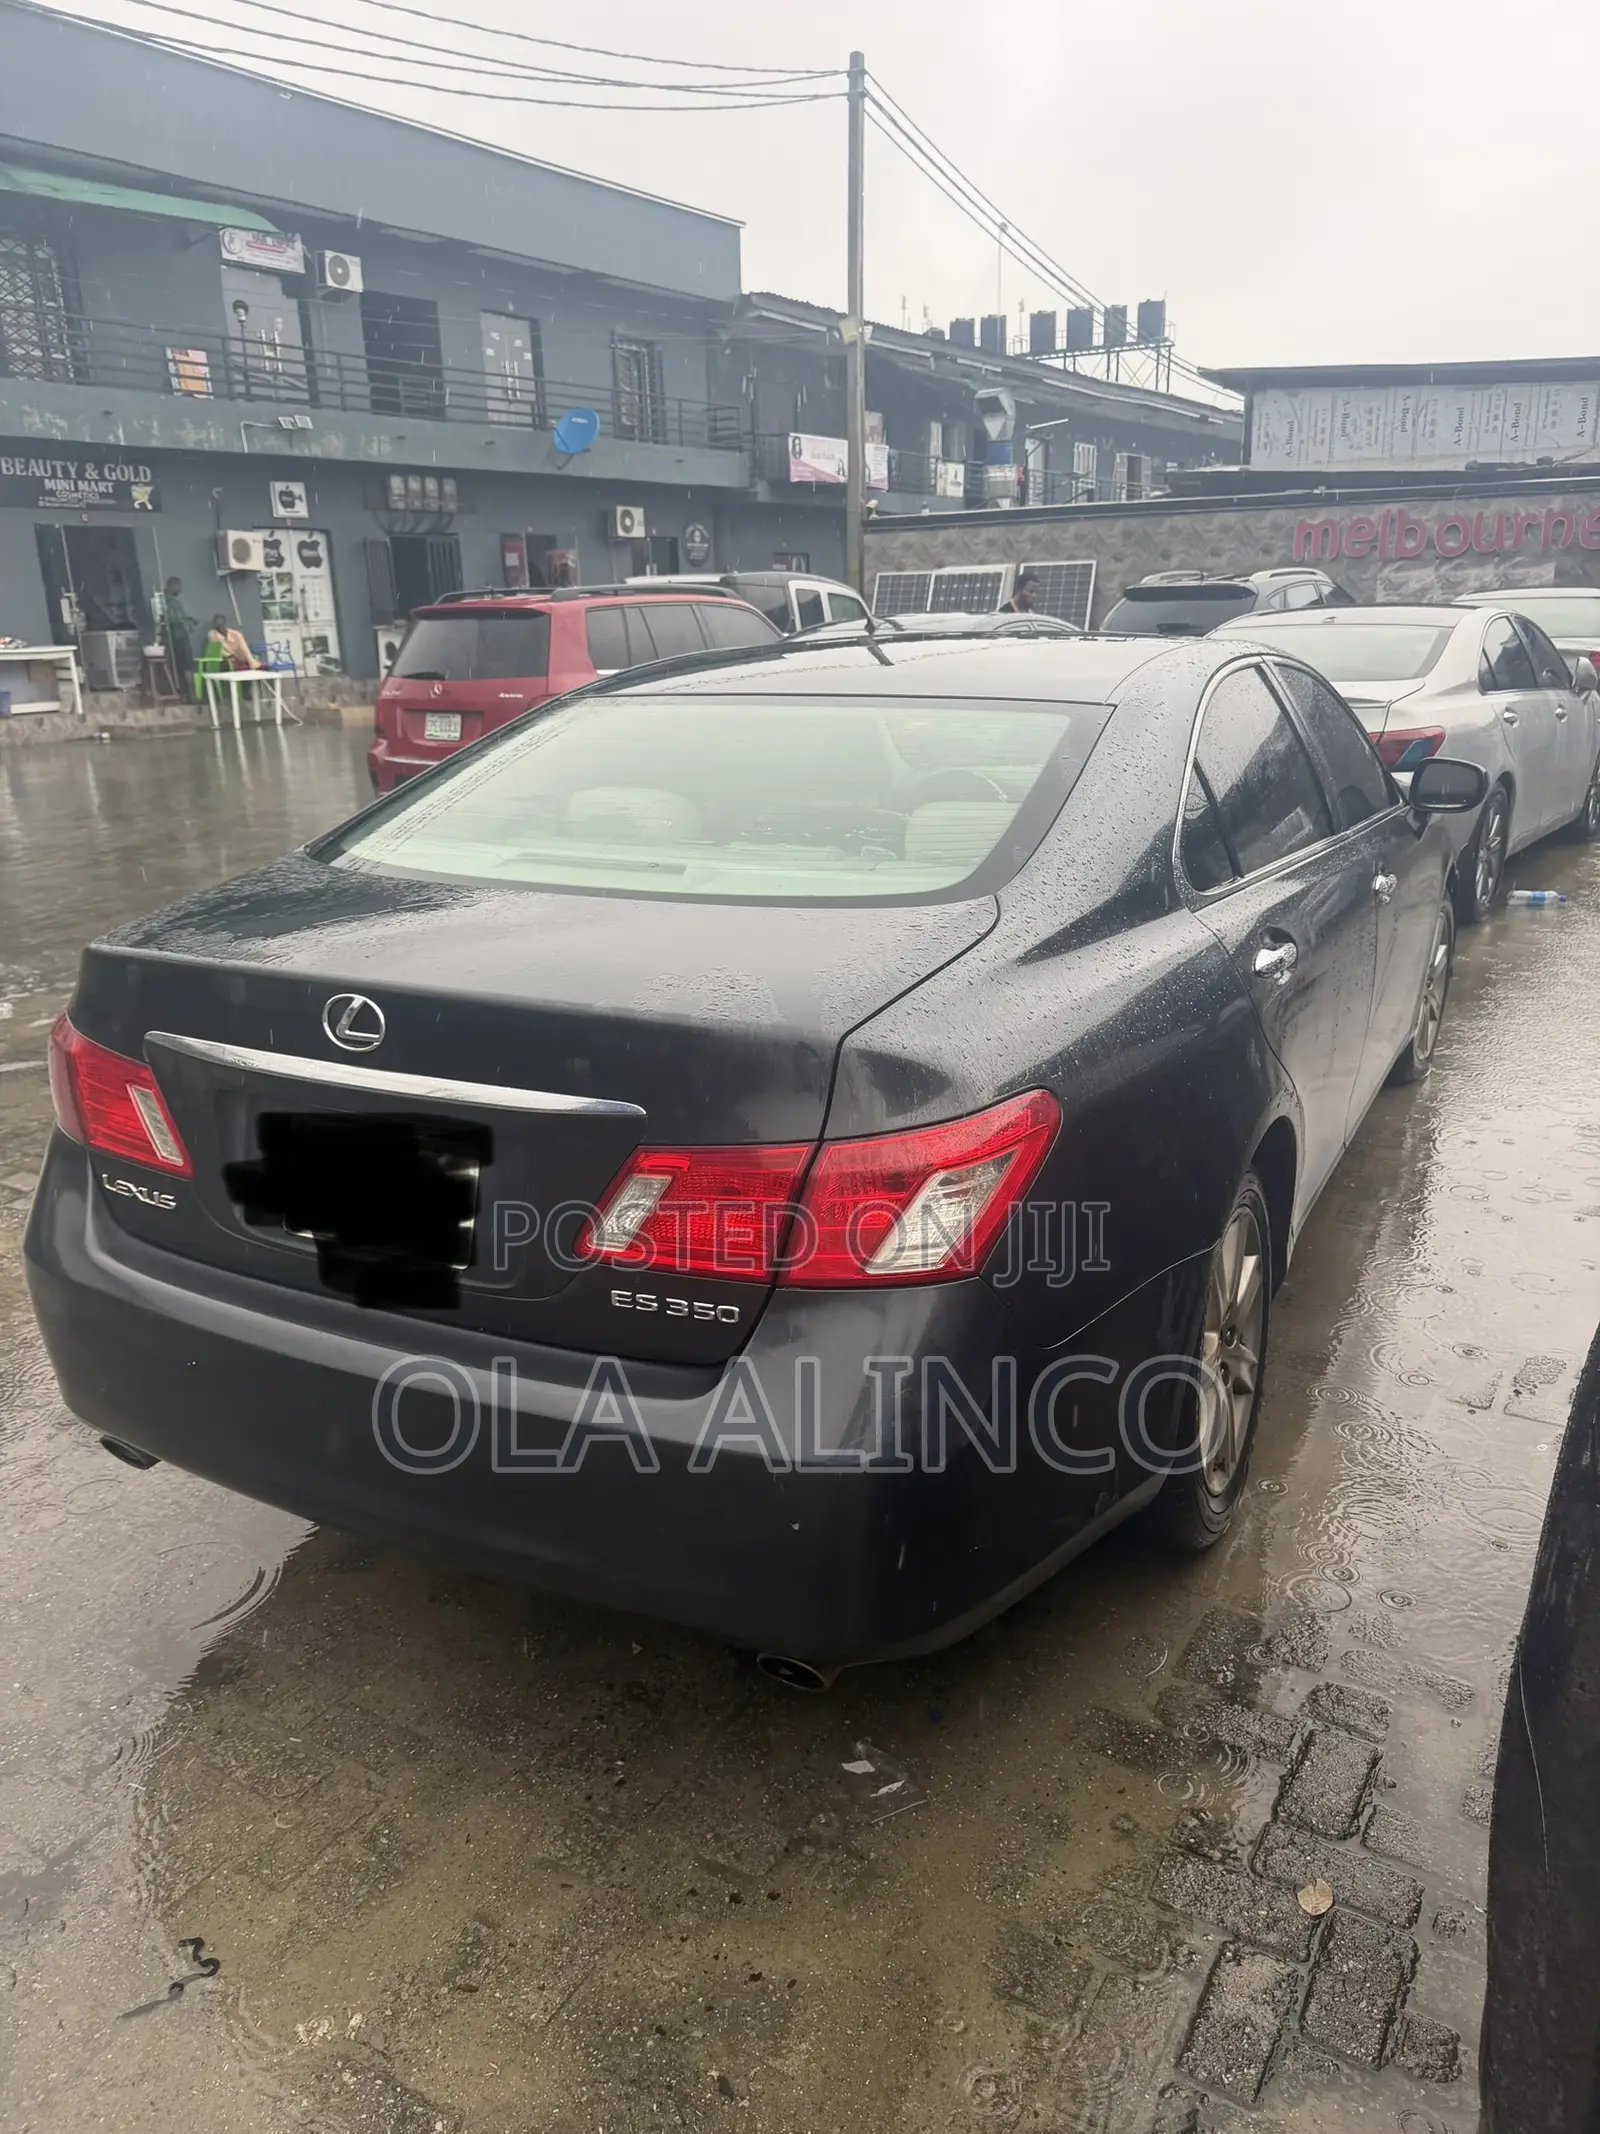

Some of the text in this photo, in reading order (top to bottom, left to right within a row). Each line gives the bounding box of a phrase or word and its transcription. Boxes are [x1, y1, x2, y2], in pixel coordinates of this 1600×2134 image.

[1400, 394, 1411, 434] A-Bond
[1453, 407, 1465, 446] A-Bond
[1509, 402, 1522, 443] A-Bond
[1576, 397, 1589, 438] A-Bond
[1284, 420, 1295, 458] A-Bond
[0, 456, 152, 483] BEAUTY & GOLD
[43, 478, 115, 494] MINI MART
[55, 490, 100, 500] COSMETICS
[1292, 507, 1600, 562] melbourne
[101, 1173, 177, 1210] LEXUS
[611, 1289, 741, 1324] ES 350
